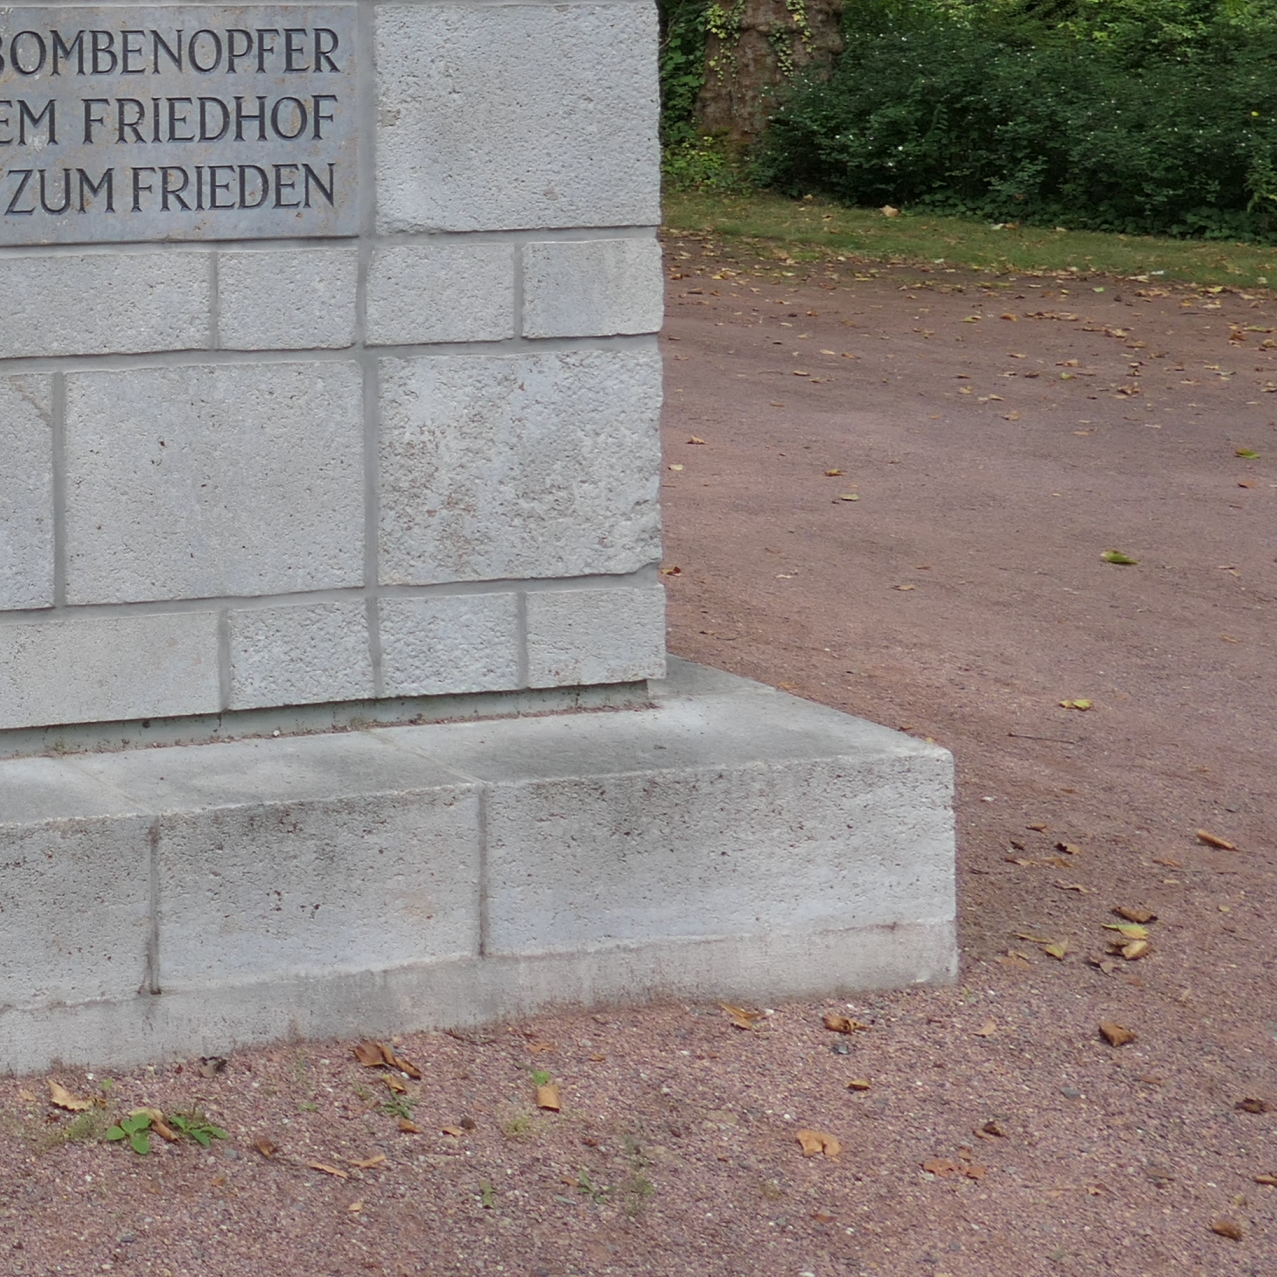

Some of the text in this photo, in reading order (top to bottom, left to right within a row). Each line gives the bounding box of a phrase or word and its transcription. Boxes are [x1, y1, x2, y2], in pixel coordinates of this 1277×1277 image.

[81, 94, 339, 146] FRIEDHOF
[3, 167, 116, 217] ZUM
[131, 162, 336, 211] FRIEDEN
